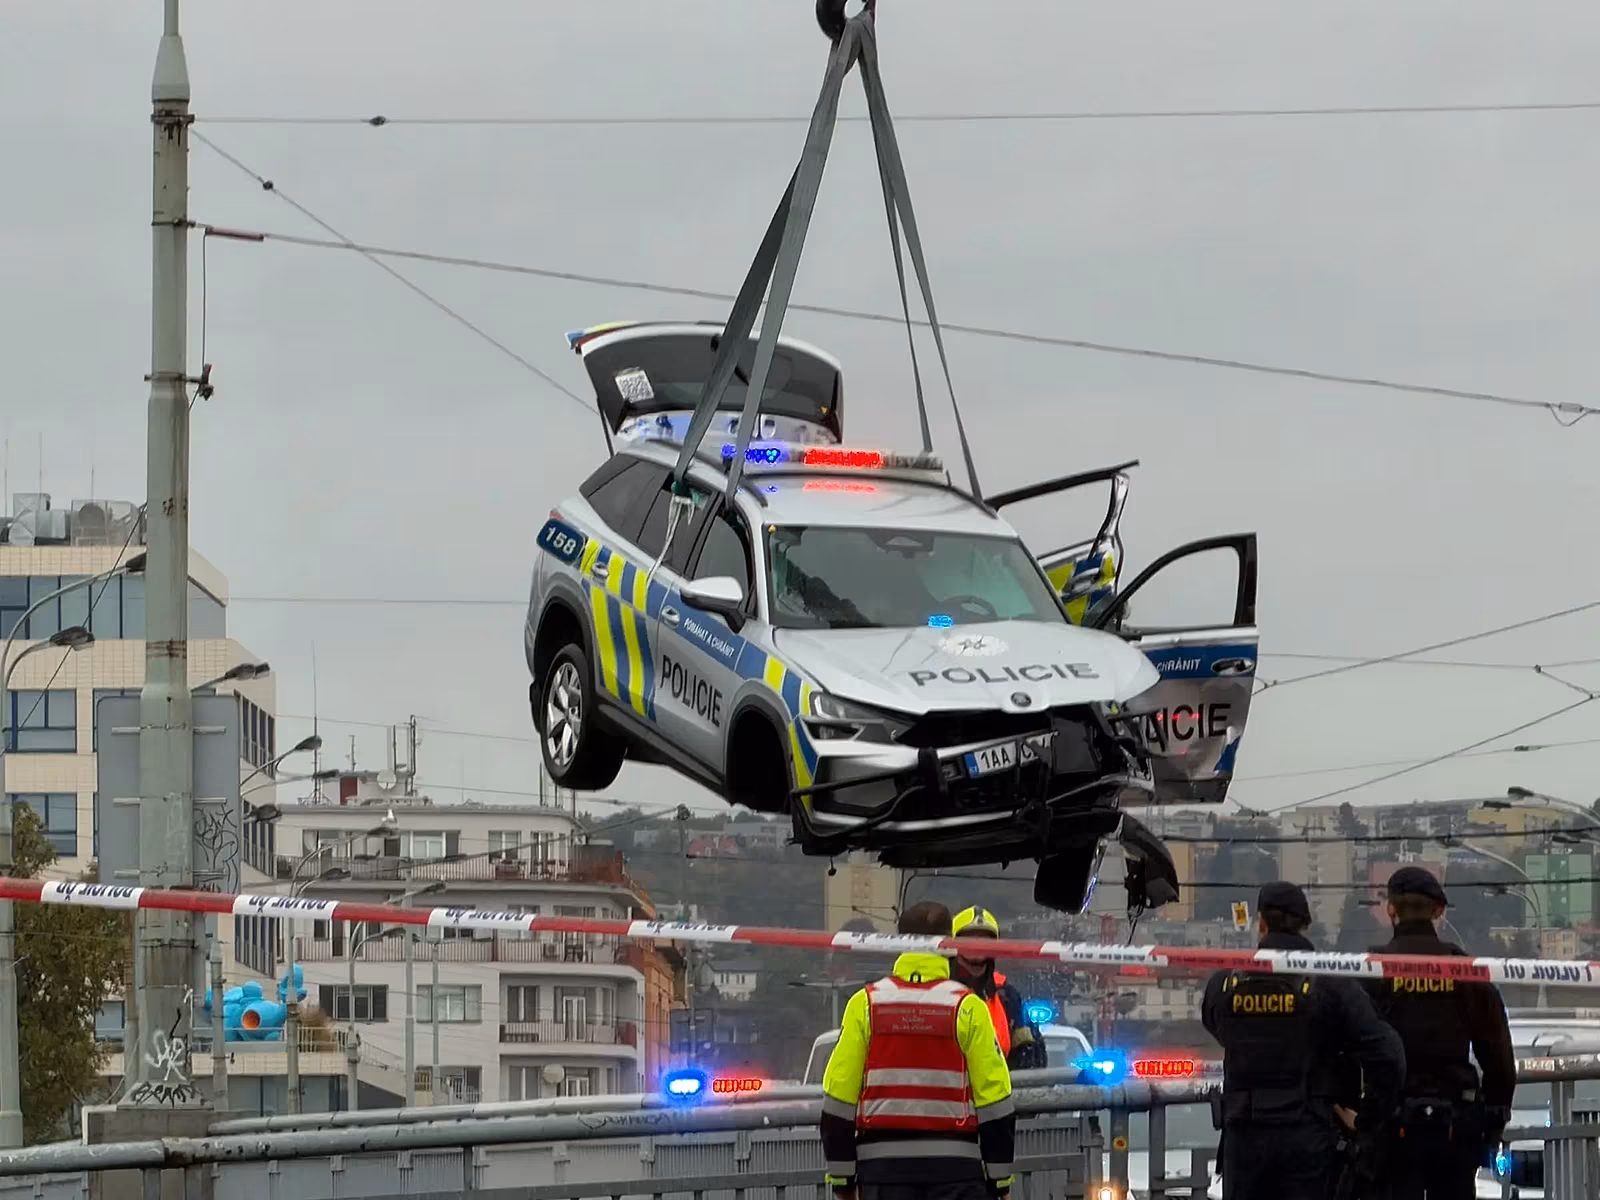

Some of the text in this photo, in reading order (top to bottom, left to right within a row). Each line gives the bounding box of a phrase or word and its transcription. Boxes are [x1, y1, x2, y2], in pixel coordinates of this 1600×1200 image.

[546, 526, 577, 555] 158
[908, 662, 1100, 687] POLICIE
[660, 654, 723, 728] POLICIE
[980, 747, 1011, 769] 1AA
[1393, 975, 1454, 993] POLICIE
[1233, 993, 1295, 1013] POLICIE
